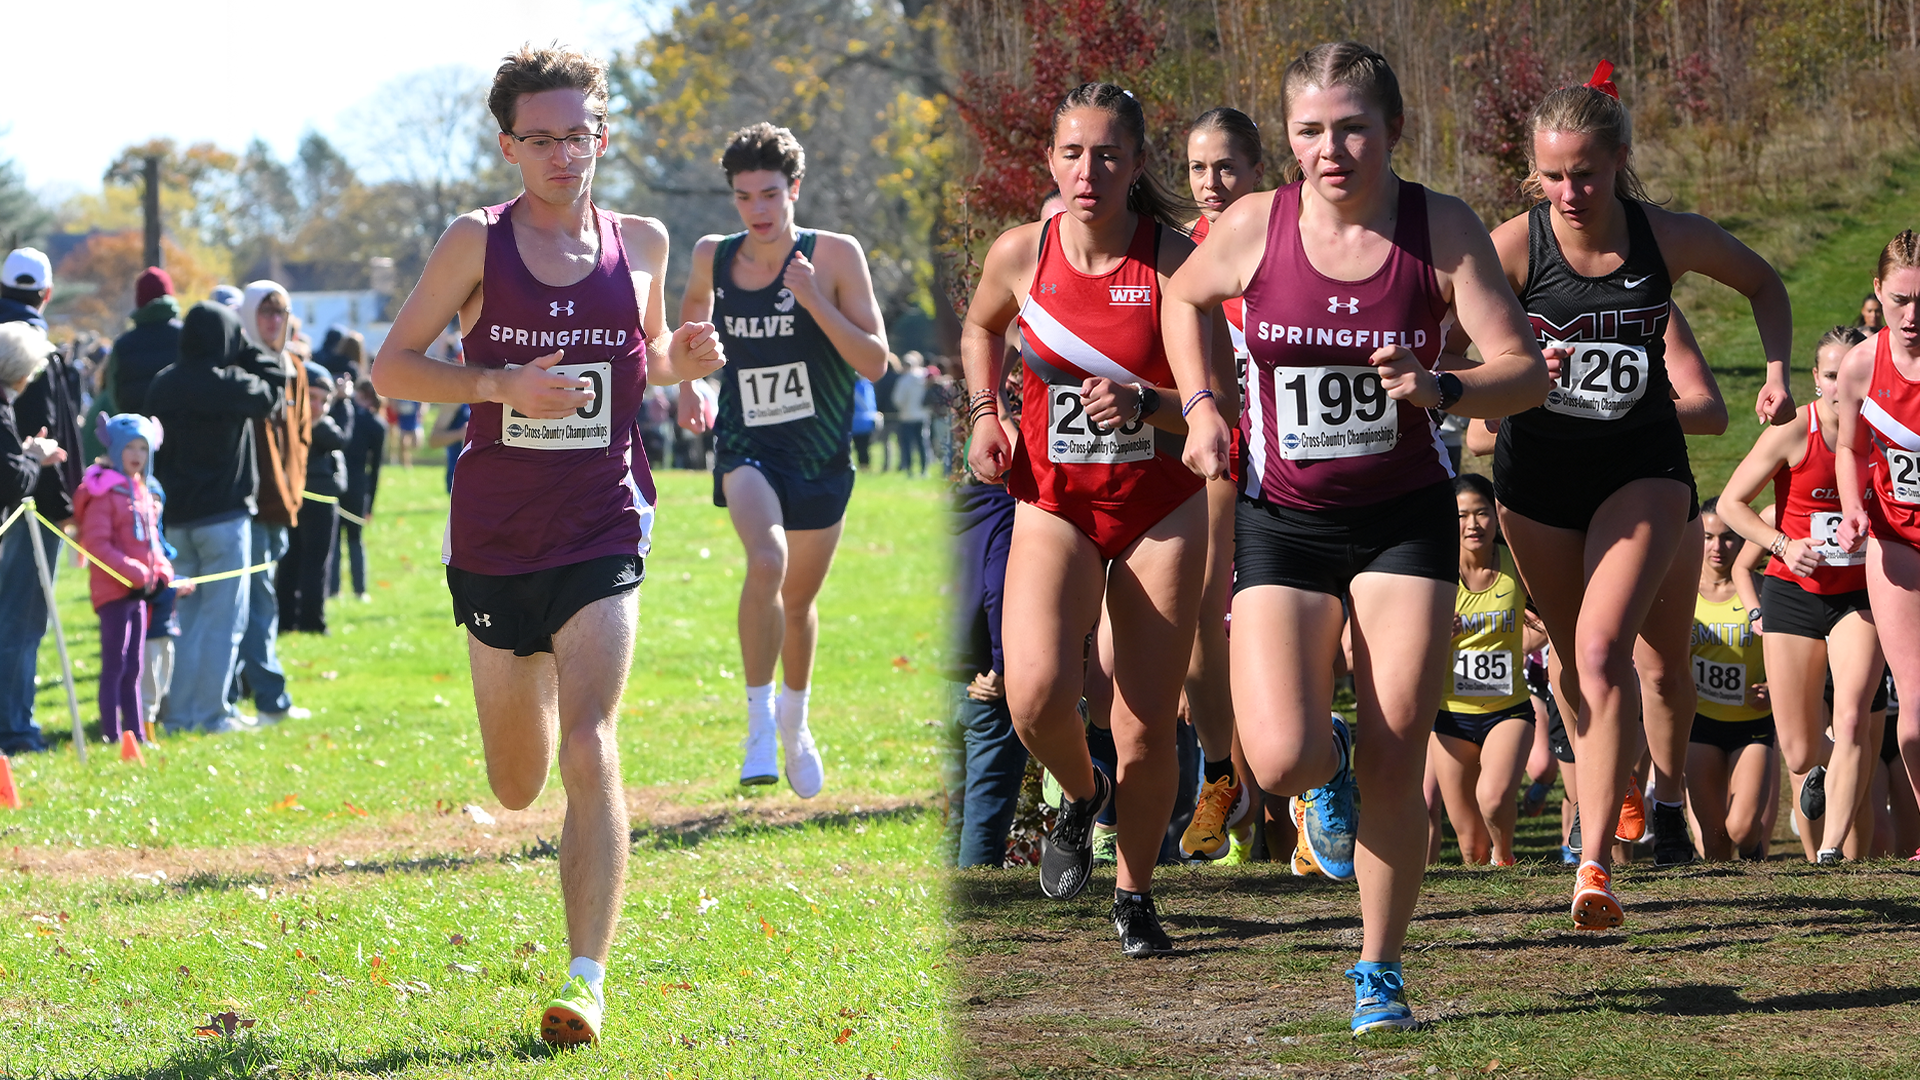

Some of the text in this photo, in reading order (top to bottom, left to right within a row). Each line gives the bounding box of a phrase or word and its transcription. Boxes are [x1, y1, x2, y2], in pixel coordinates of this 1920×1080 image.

[1109, 289, 1151, 302] WPI
[490, 324, 627, 347] SPRINGFIELD
[1258, 321, 1427, 348] SPRINGFIELD
[1528, 301, 1669, 343] MIT
[1561, 350, 1639, 394] 126
[745, 368, 804, 404] 174
[1285, 372, 1388, 426] 199
[524, 423, 608, 440] Cross-Country Championships
[1301, 426, 1394, 448] Cross-Country Championships
[1069, 438, 1151, 455] Cross-Country Championships
[1460, 608, 1515, 635] MITH
[1458, 654, 1506, 680] 185
[1696, 661, 1741, 691] 188
